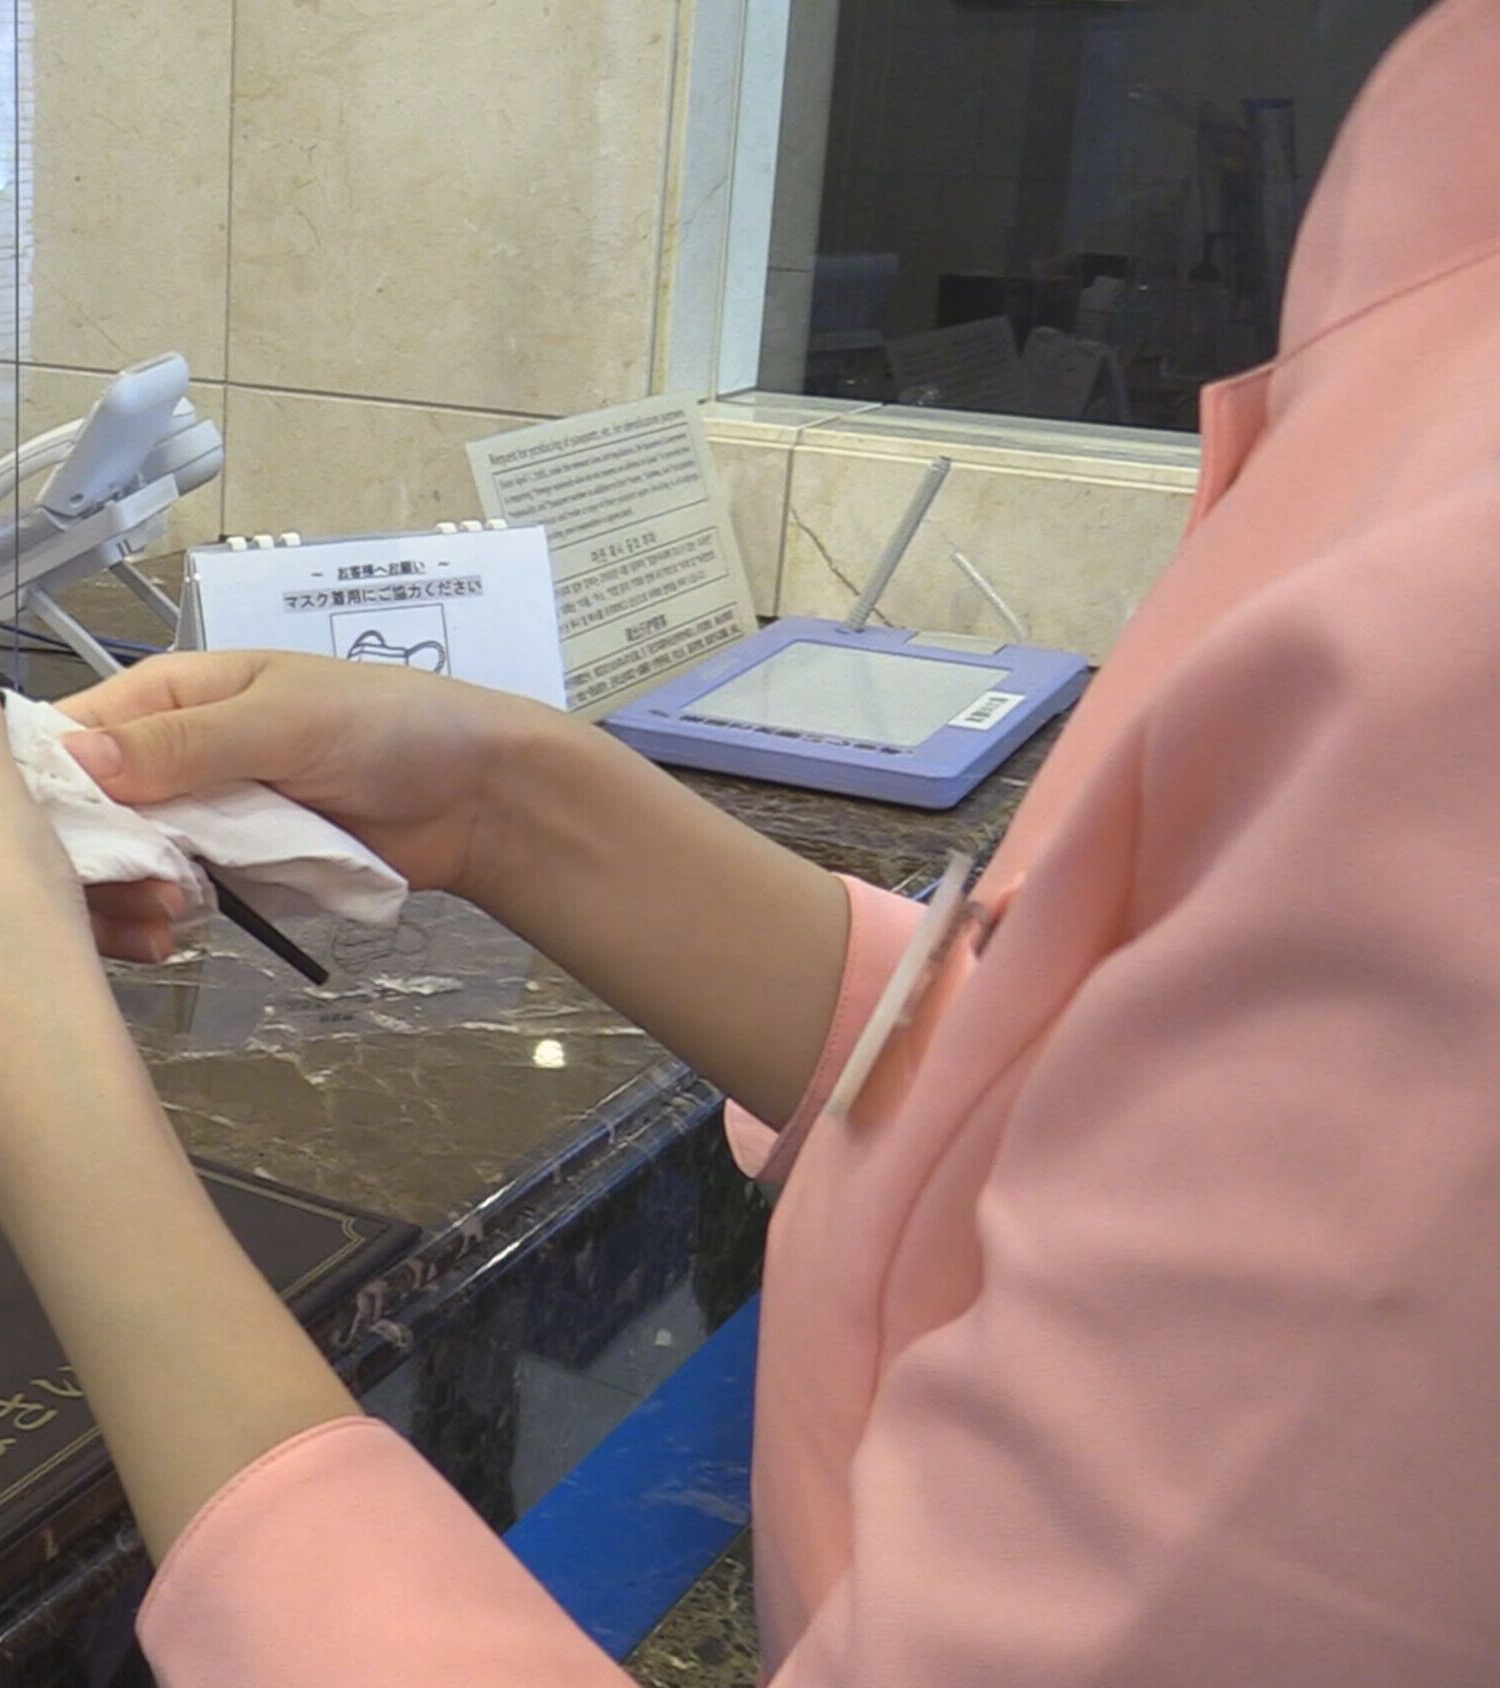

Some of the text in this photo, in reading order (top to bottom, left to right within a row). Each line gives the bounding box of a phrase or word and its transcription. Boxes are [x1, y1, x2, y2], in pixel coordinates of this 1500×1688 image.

[338, 560, 425, 581] お客様へお願い
[284, 578, 482, 610] マスク着用にご協力ください
